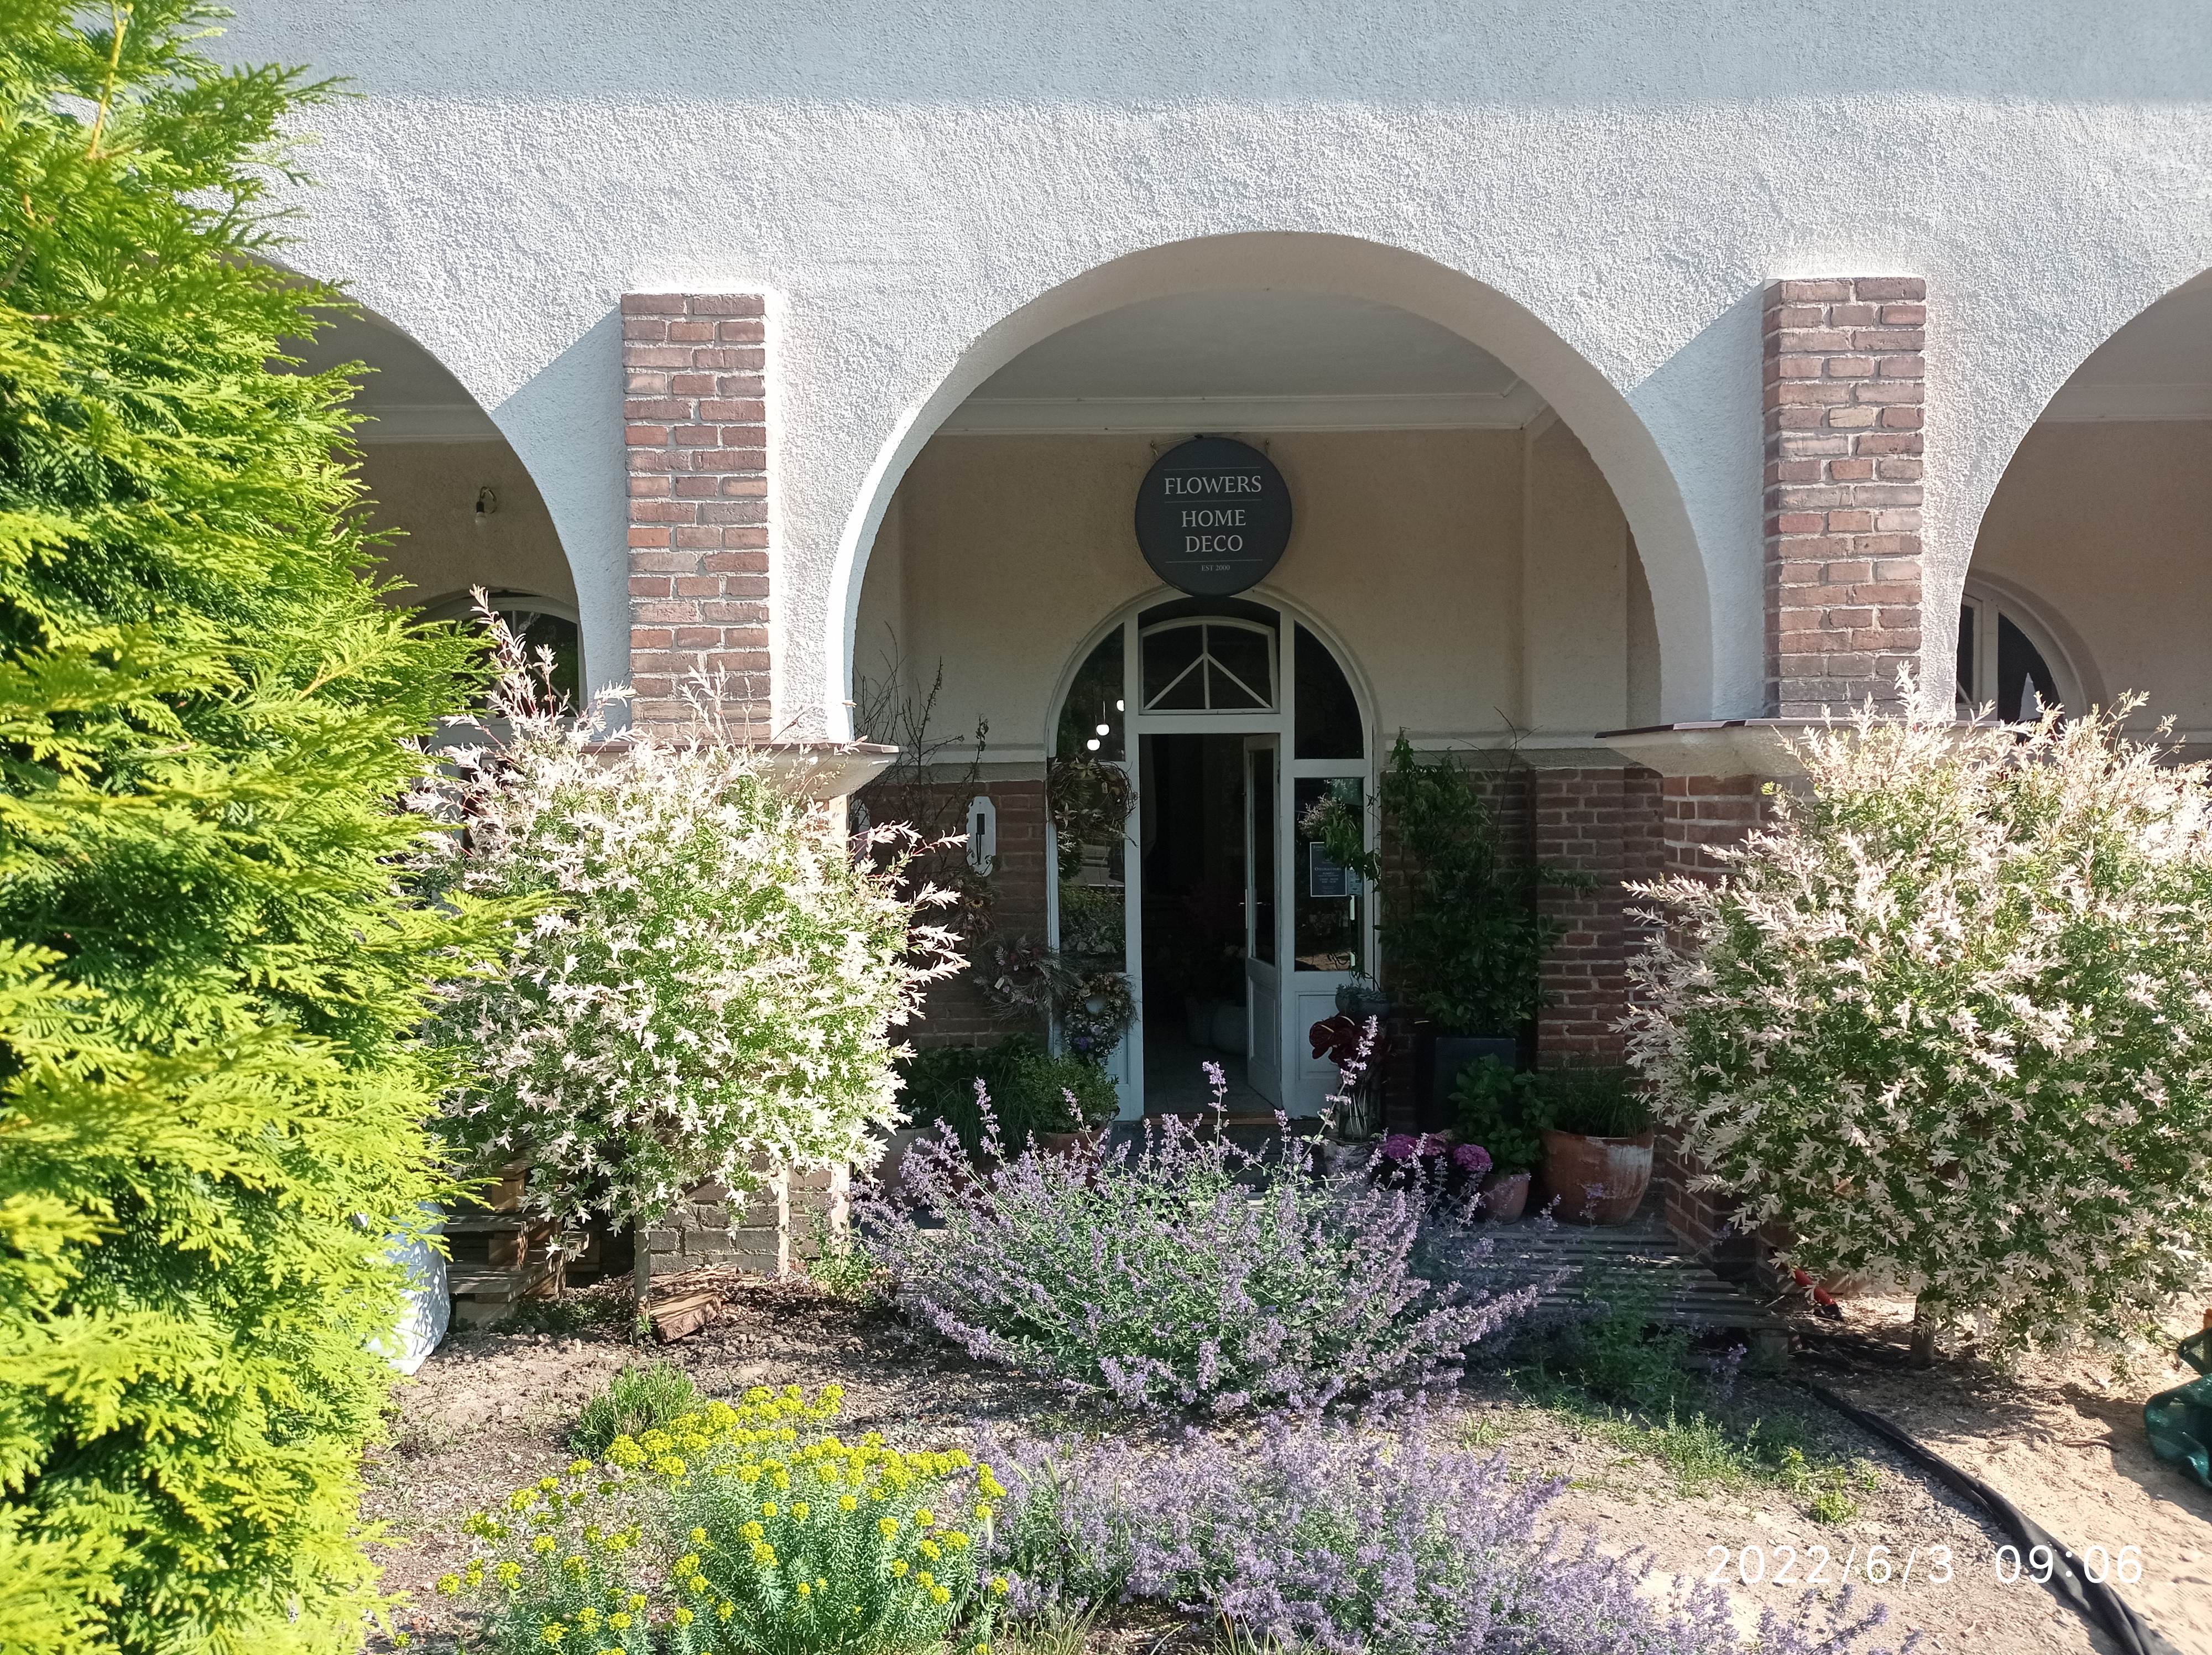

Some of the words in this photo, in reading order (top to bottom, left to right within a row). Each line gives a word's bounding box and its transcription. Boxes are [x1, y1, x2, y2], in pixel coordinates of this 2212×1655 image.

[1164, 476, 1261, 494] FLOWERS
[1182, 509, 1246, 527] HOME
[1185, 535, 1243, 552] DECO
